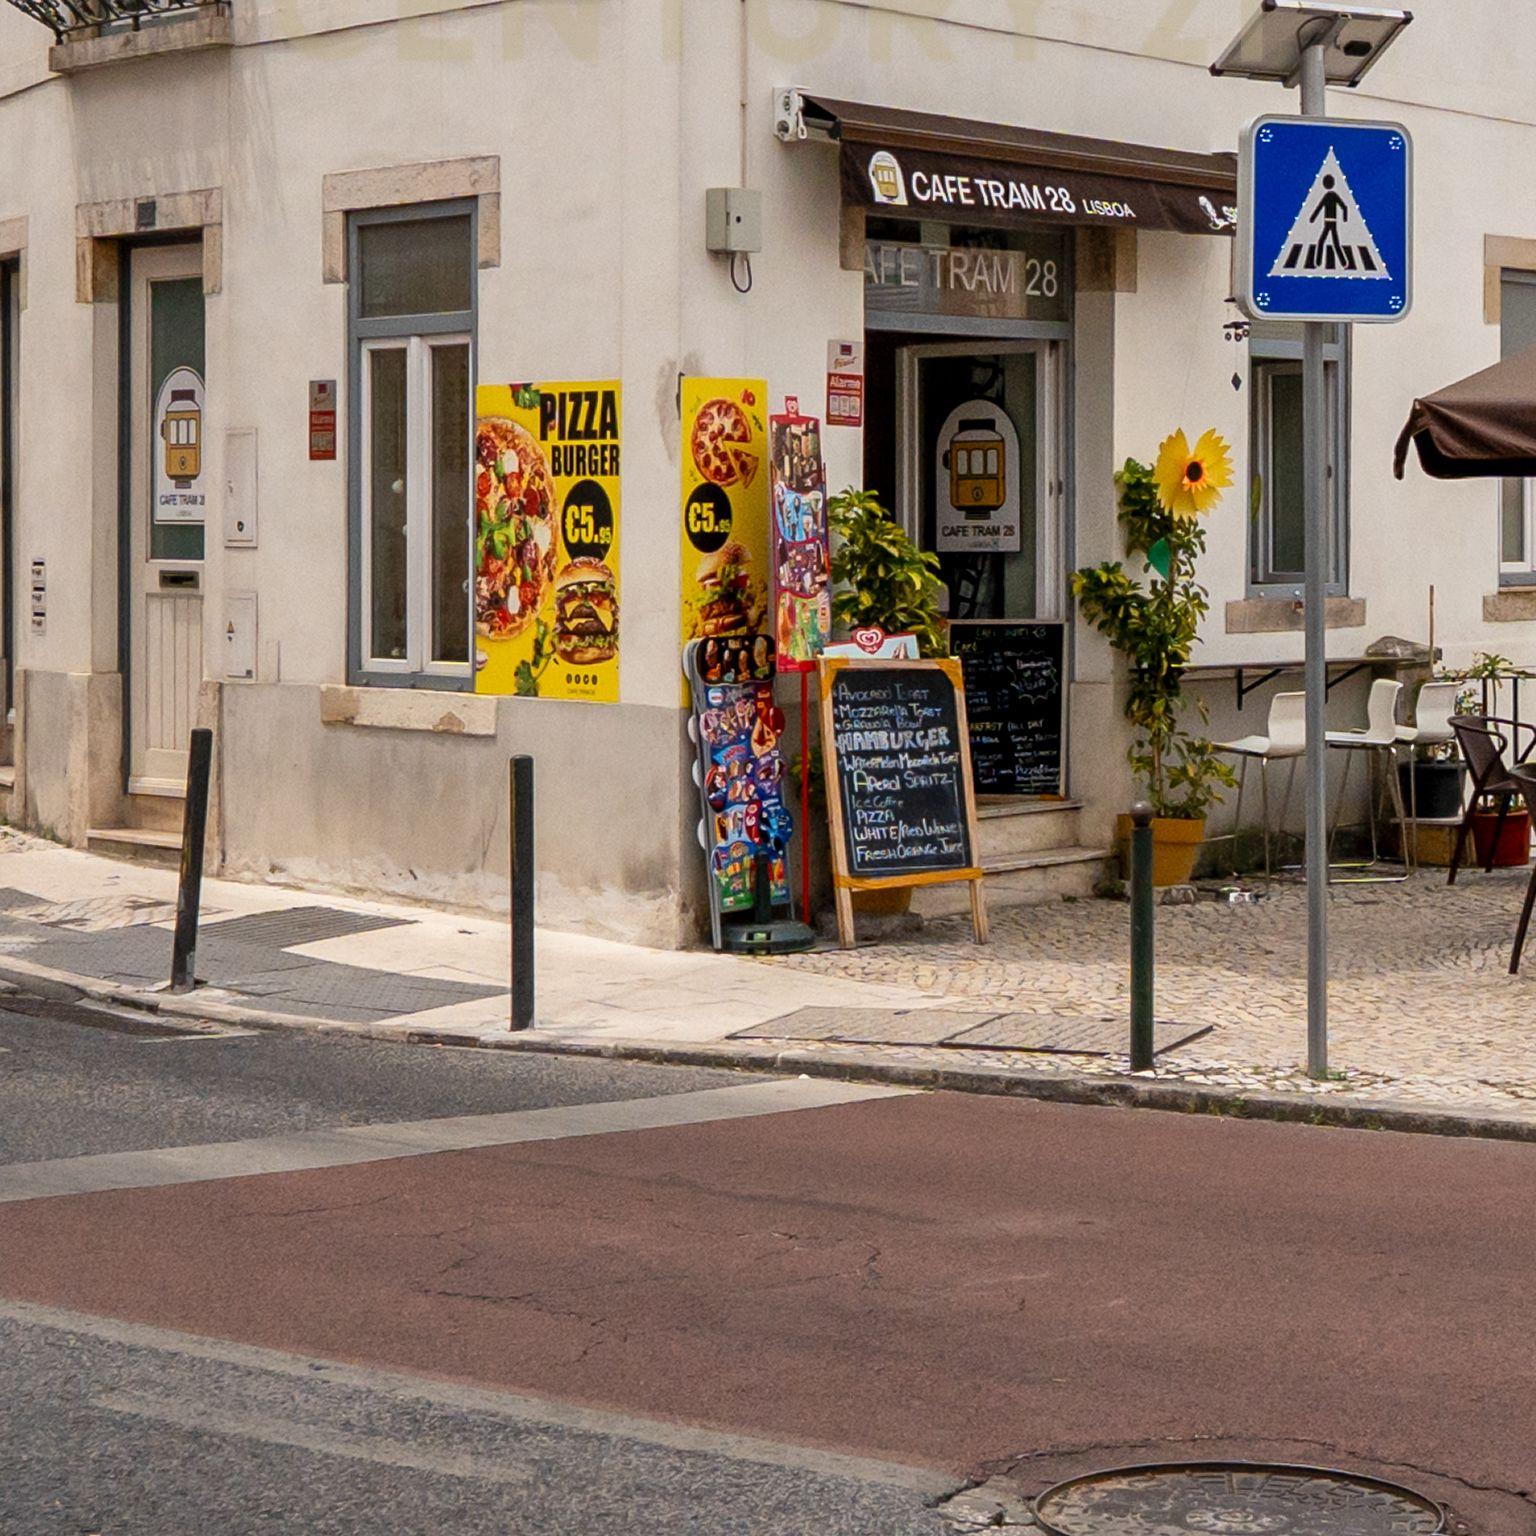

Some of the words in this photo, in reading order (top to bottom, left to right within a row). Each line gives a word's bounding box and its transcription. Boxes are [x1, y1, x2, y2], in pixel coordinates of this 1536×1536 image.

[911, 170, 975, 206] CAFE
[974, 178, 1047, 210] TRAM
[1045, 185, 1077, 214] 28
[1082, 198, 1137, 218] LISBOA
[864, 245, 919, 286] AFE
[929, 249, 1015, 294] TRAM
[1025, 258, 1059, 298] 28
[539, 390, 619, 441] PIZZA
[551, 444, 620, 477] BURGER
[941, 525, 969, 537] CAFE
[971, 525, 1001, 537] TRAM
[836, 726, 951, 754] HAMBURGER
[856, 809, 895, 825] PIZZA
